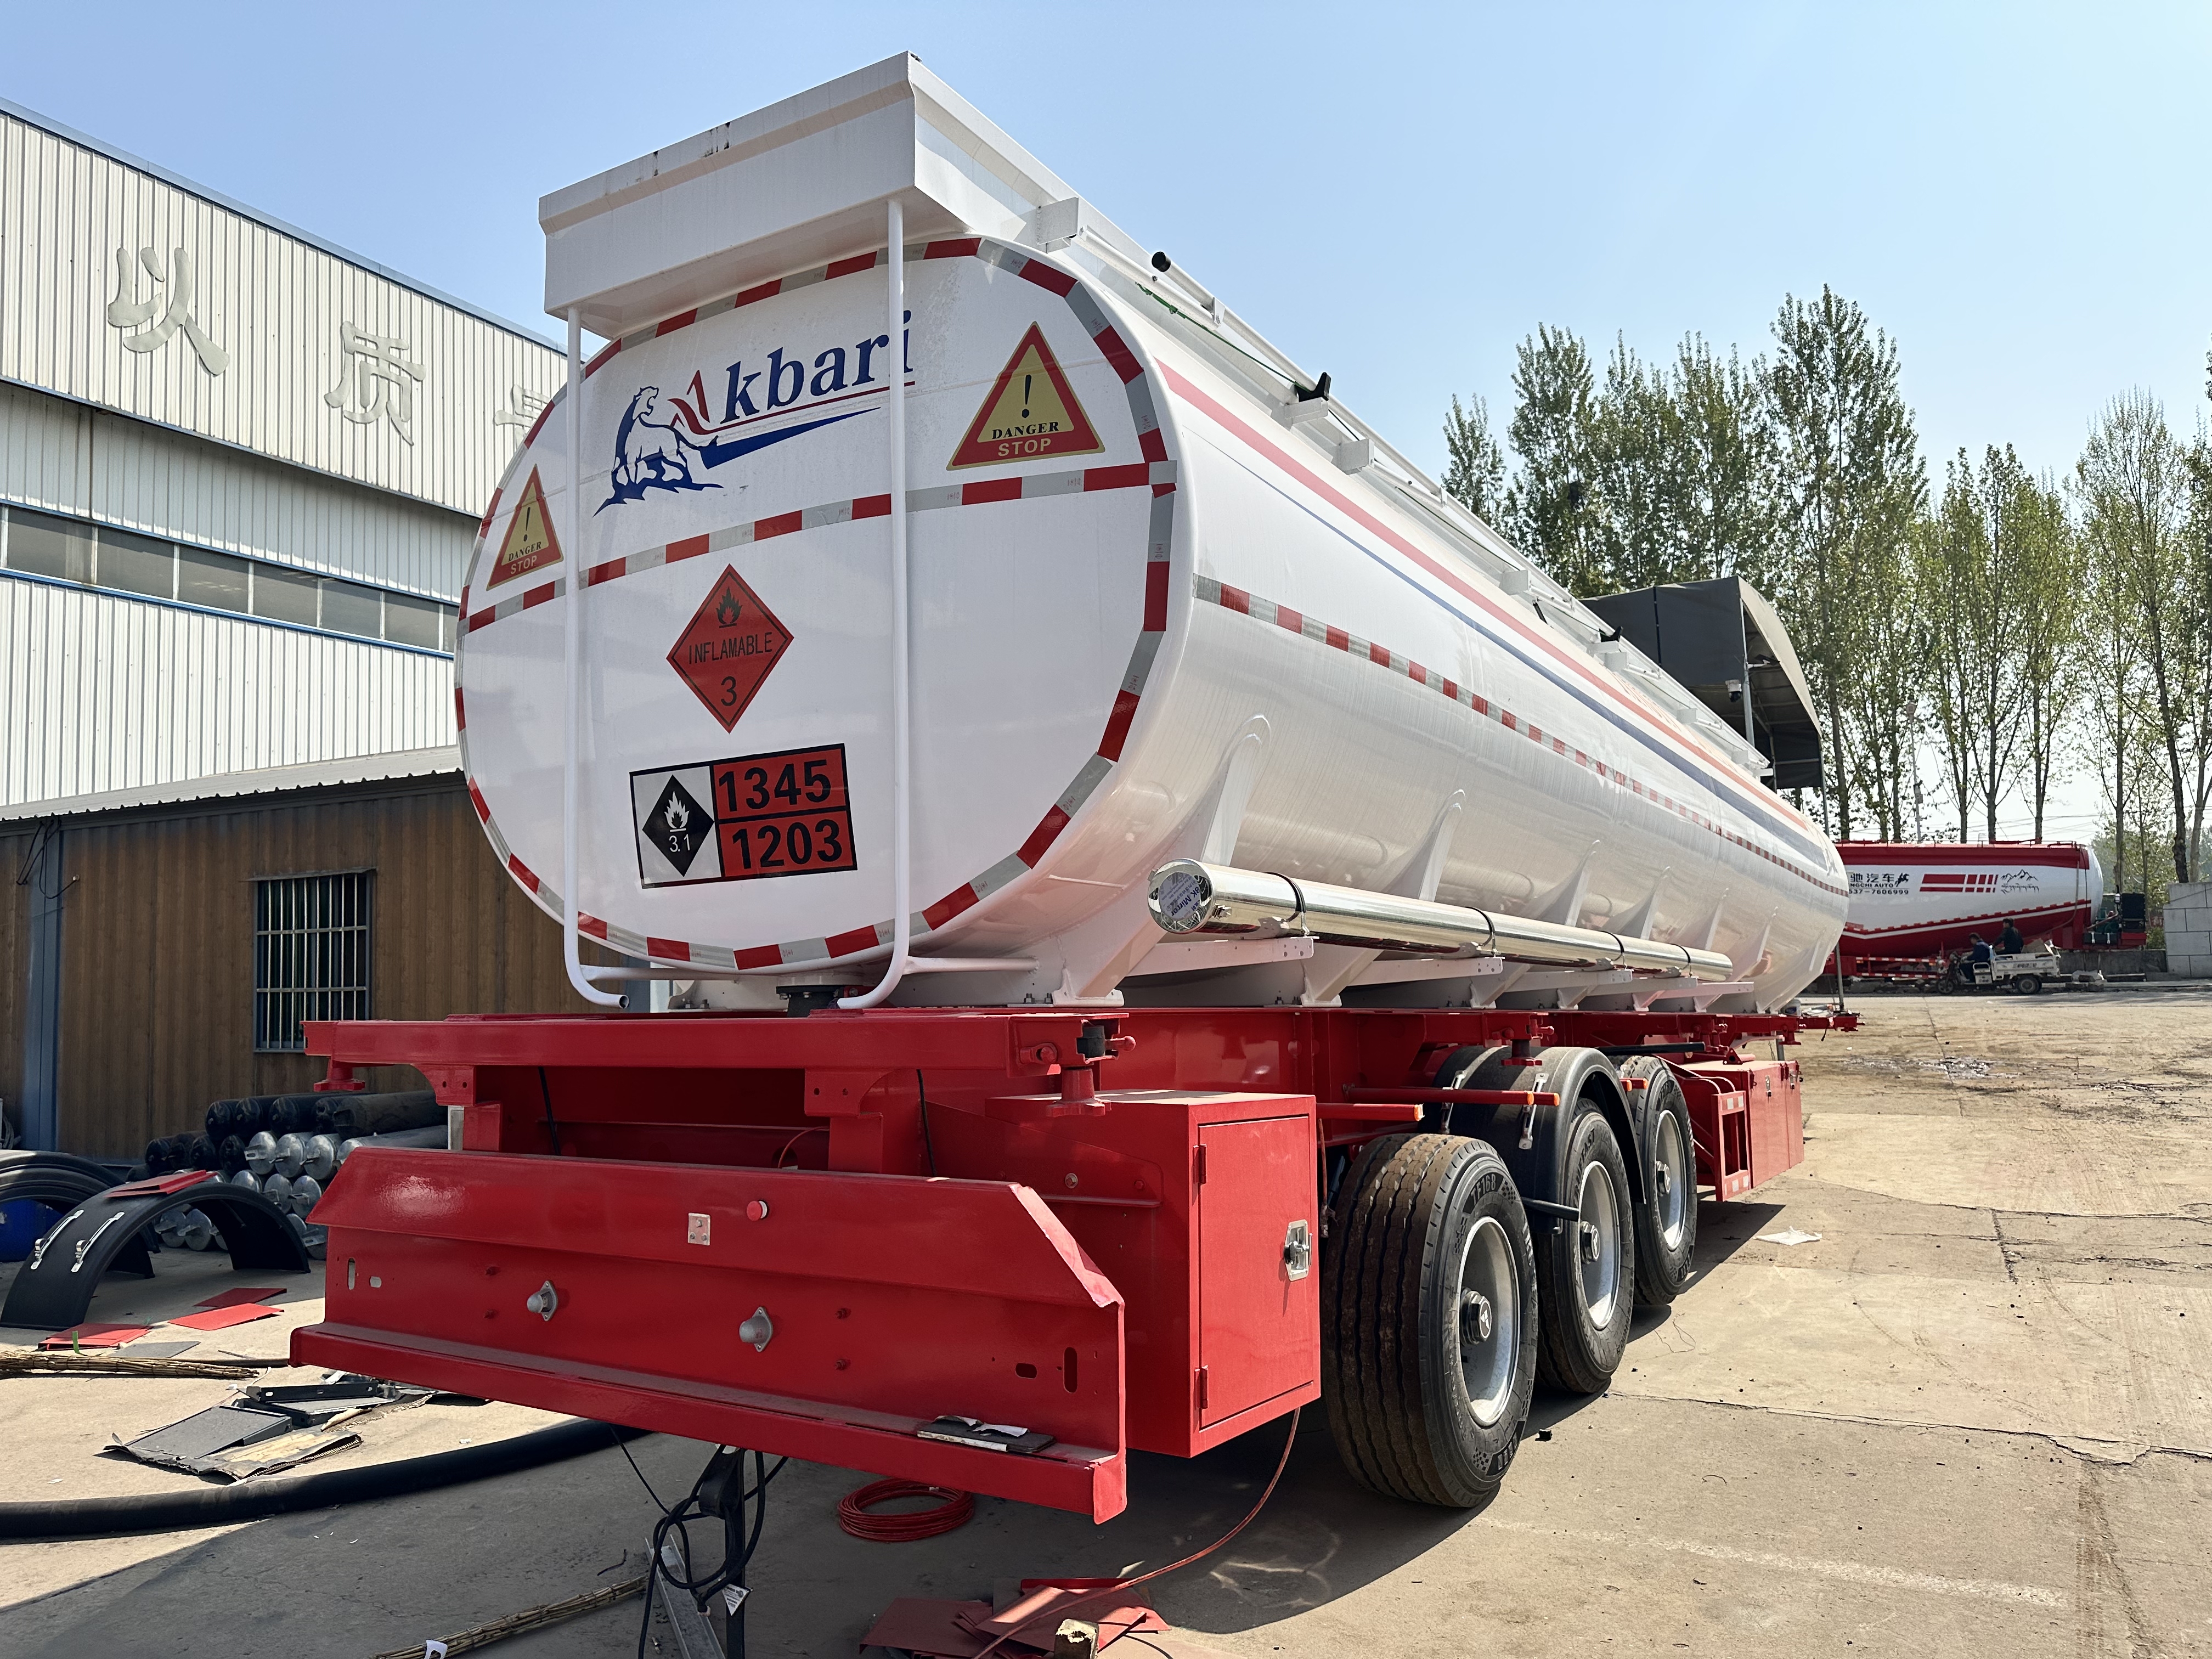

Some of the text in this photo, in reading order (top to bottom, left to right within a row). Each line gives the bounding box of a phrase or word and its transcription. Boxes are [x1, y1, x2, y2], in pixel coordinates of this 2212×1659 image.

[668, 310, 914, 435] Akbari
[991, 421, 1059, 440] DANGER
[998, 438, 1051, 456] STOP
[508, 541, 541, 562] DANGER
[510, 555, 537, 574] STOP
[689, 632, 772, 665] INFLAMABLE
[720, 676, 737, 707] 3
[719, 759, 831, 812] 1345
[669, 834, 691, 853] 3.1
[732, 819, 843, 870] 1203
[1171, 895, 1192, 917] Mirror
[1471, 1173, 1496, 1206] TF168
